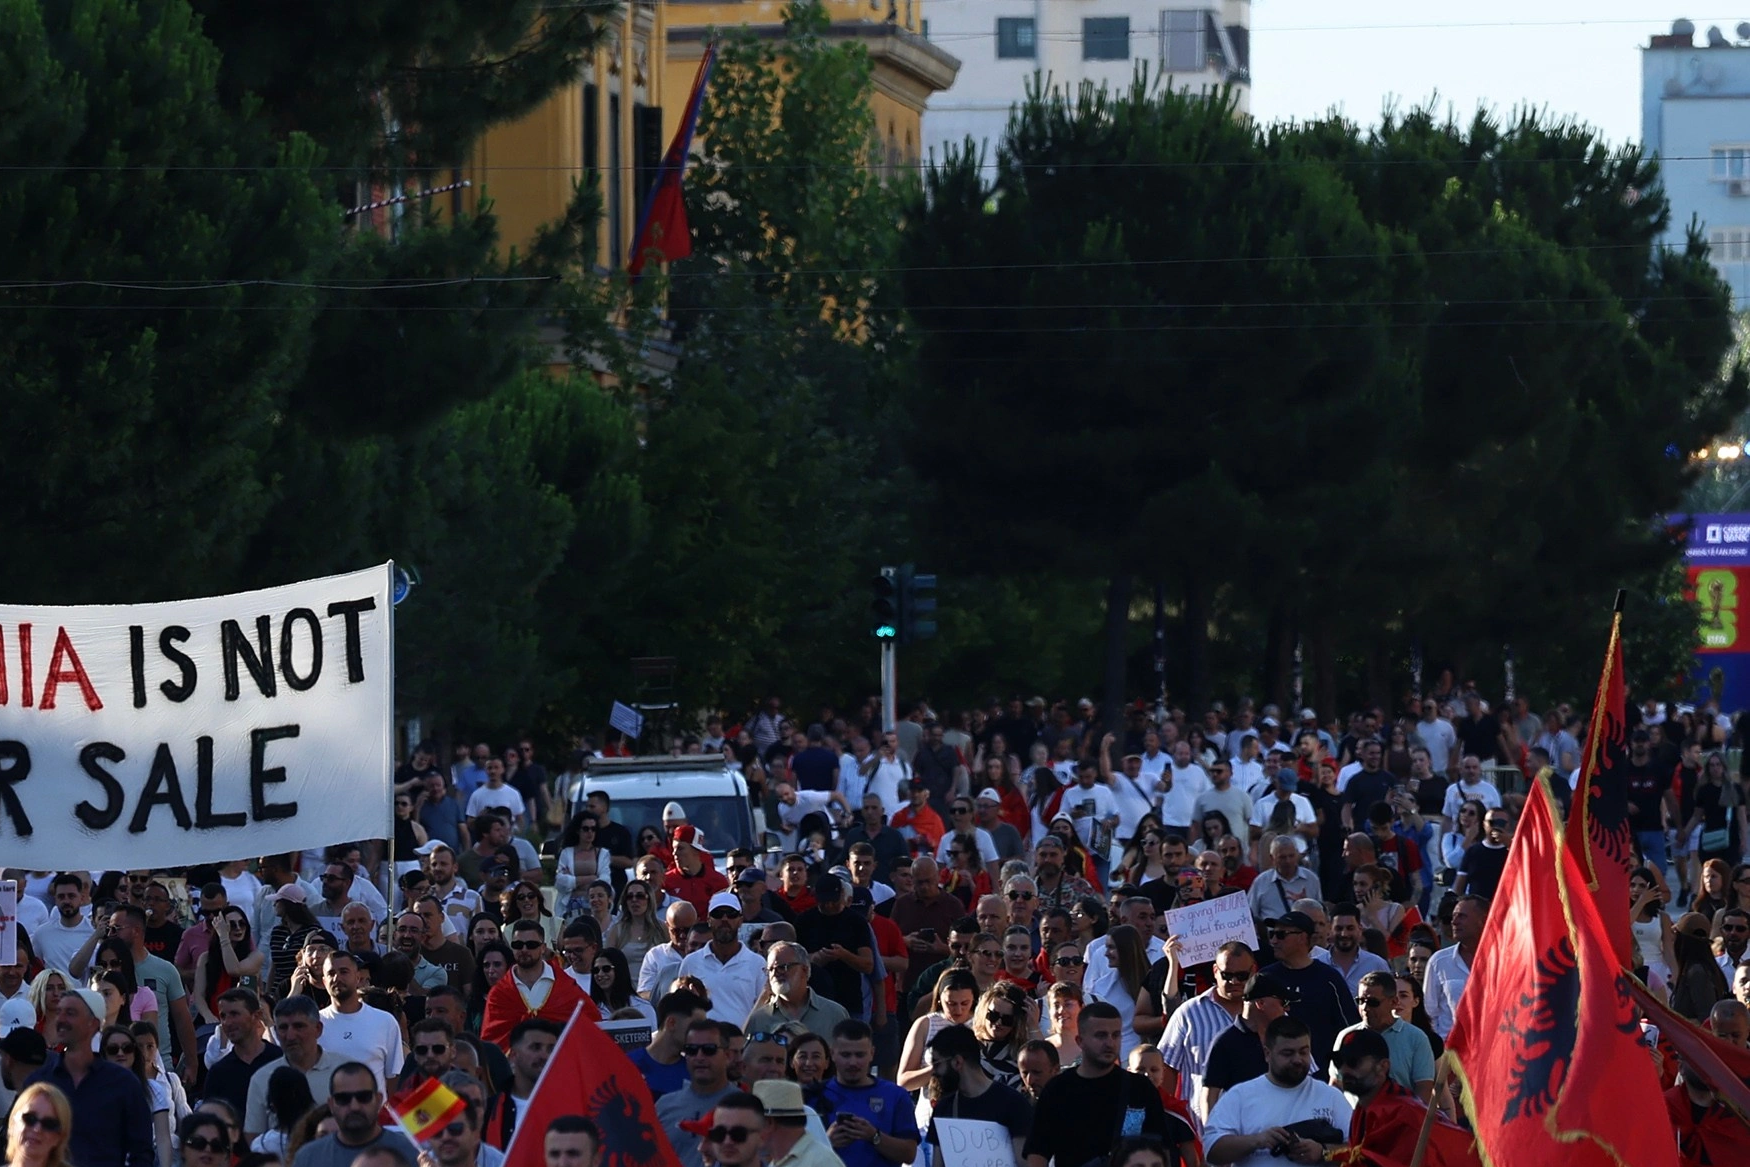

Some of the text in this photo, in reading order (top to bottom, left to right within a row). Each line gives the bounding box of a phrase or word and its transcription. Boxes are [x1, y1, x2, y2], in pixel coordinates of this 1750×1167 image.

[129, 625, 198, 708] IS
[221, 596, 377, 701] NOT
[75, 724, 300, 833] SALE
[1166, 911, 1185, 925] It's
[1187, 907, 1213, 927] giving
